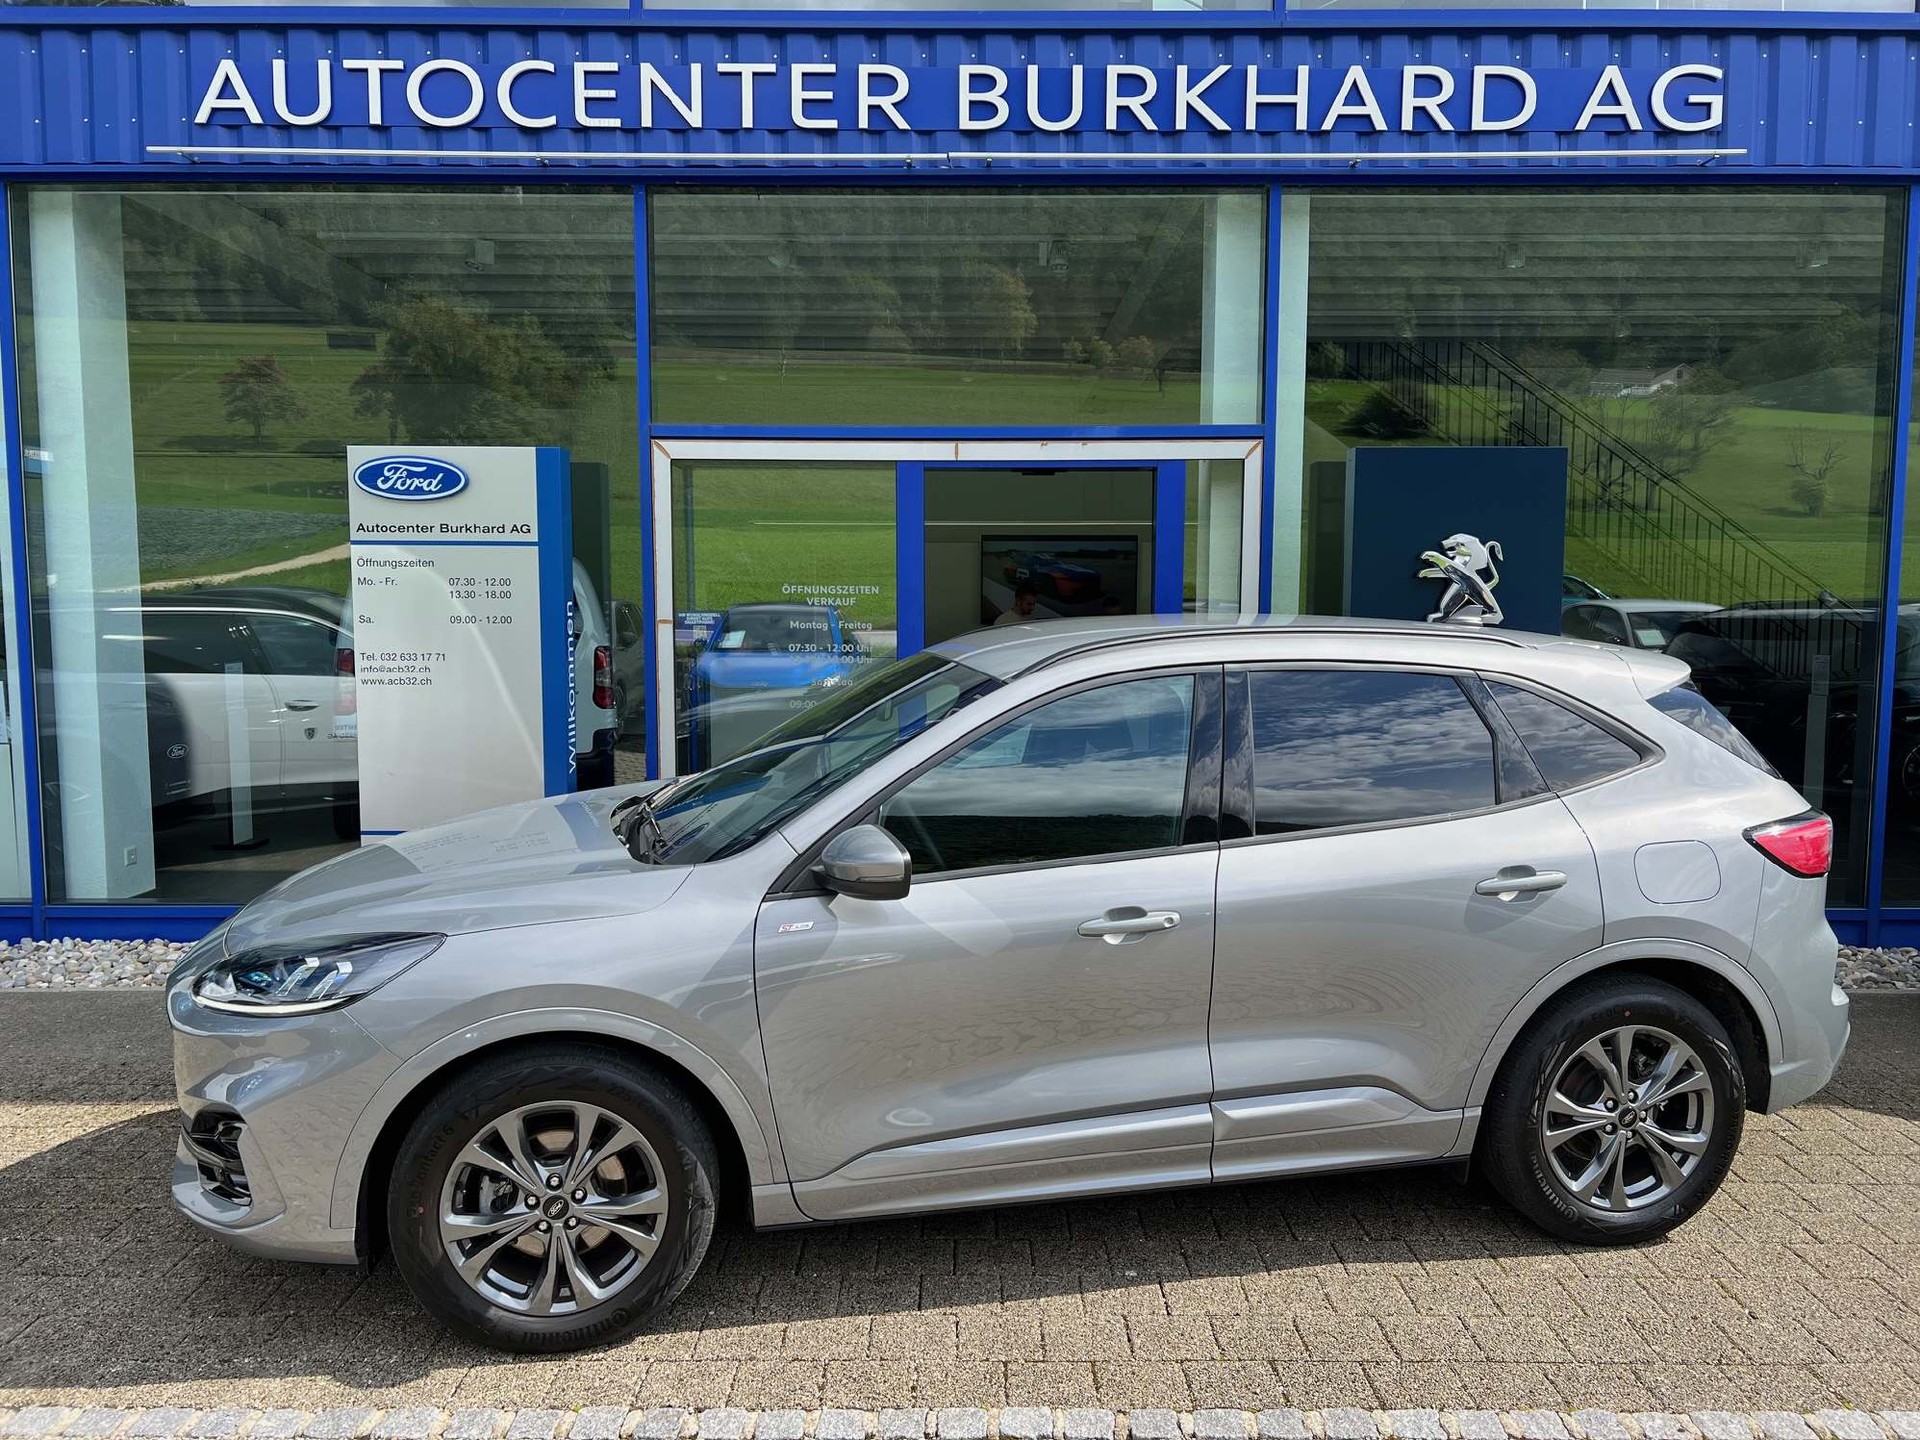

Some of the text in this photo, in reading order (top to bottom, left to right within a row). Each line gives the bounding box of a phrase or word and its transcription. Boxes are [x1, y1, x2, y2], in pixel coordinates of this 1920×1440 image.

[194, 59, 1727, 133] AUTOCENTER BURKHARD AG
[355, 523, 532, 534] Autocenter Burkhard AG
[356, 557, 435, 570] Öffnungszeiten
[357, 577, 376, 586] Mo.
[385, 577, 398, 586] Fr.
[448, 577, 476, 587] 07.30
[484, 577, 512, 587] 12.00
[781, 583, 880, 595] ÖFFNUNGSZEITEN
[449, 590, 476, 599] 13.30
[485, 590, 512, 599] 18.00
[806, 597, 857, 606] VERKAUF
[358, 615, 375, 624] Sa.
[449, 615, 477, 625] 09.00
[485, 615, 513, 625] 12.00
[789, 620, 829, 630] Montag
[788, 643, 817, 652] 07:30
[827, 643, 855, 652] 12:00
[360, 653, 446, 661] Tel. 032 633 17 71
[360, 665, 431, 673] info@acb32.ch
[360, 676, 432, 686] www.acb32.ch
[566, 600, 576, 775] Willkommen
